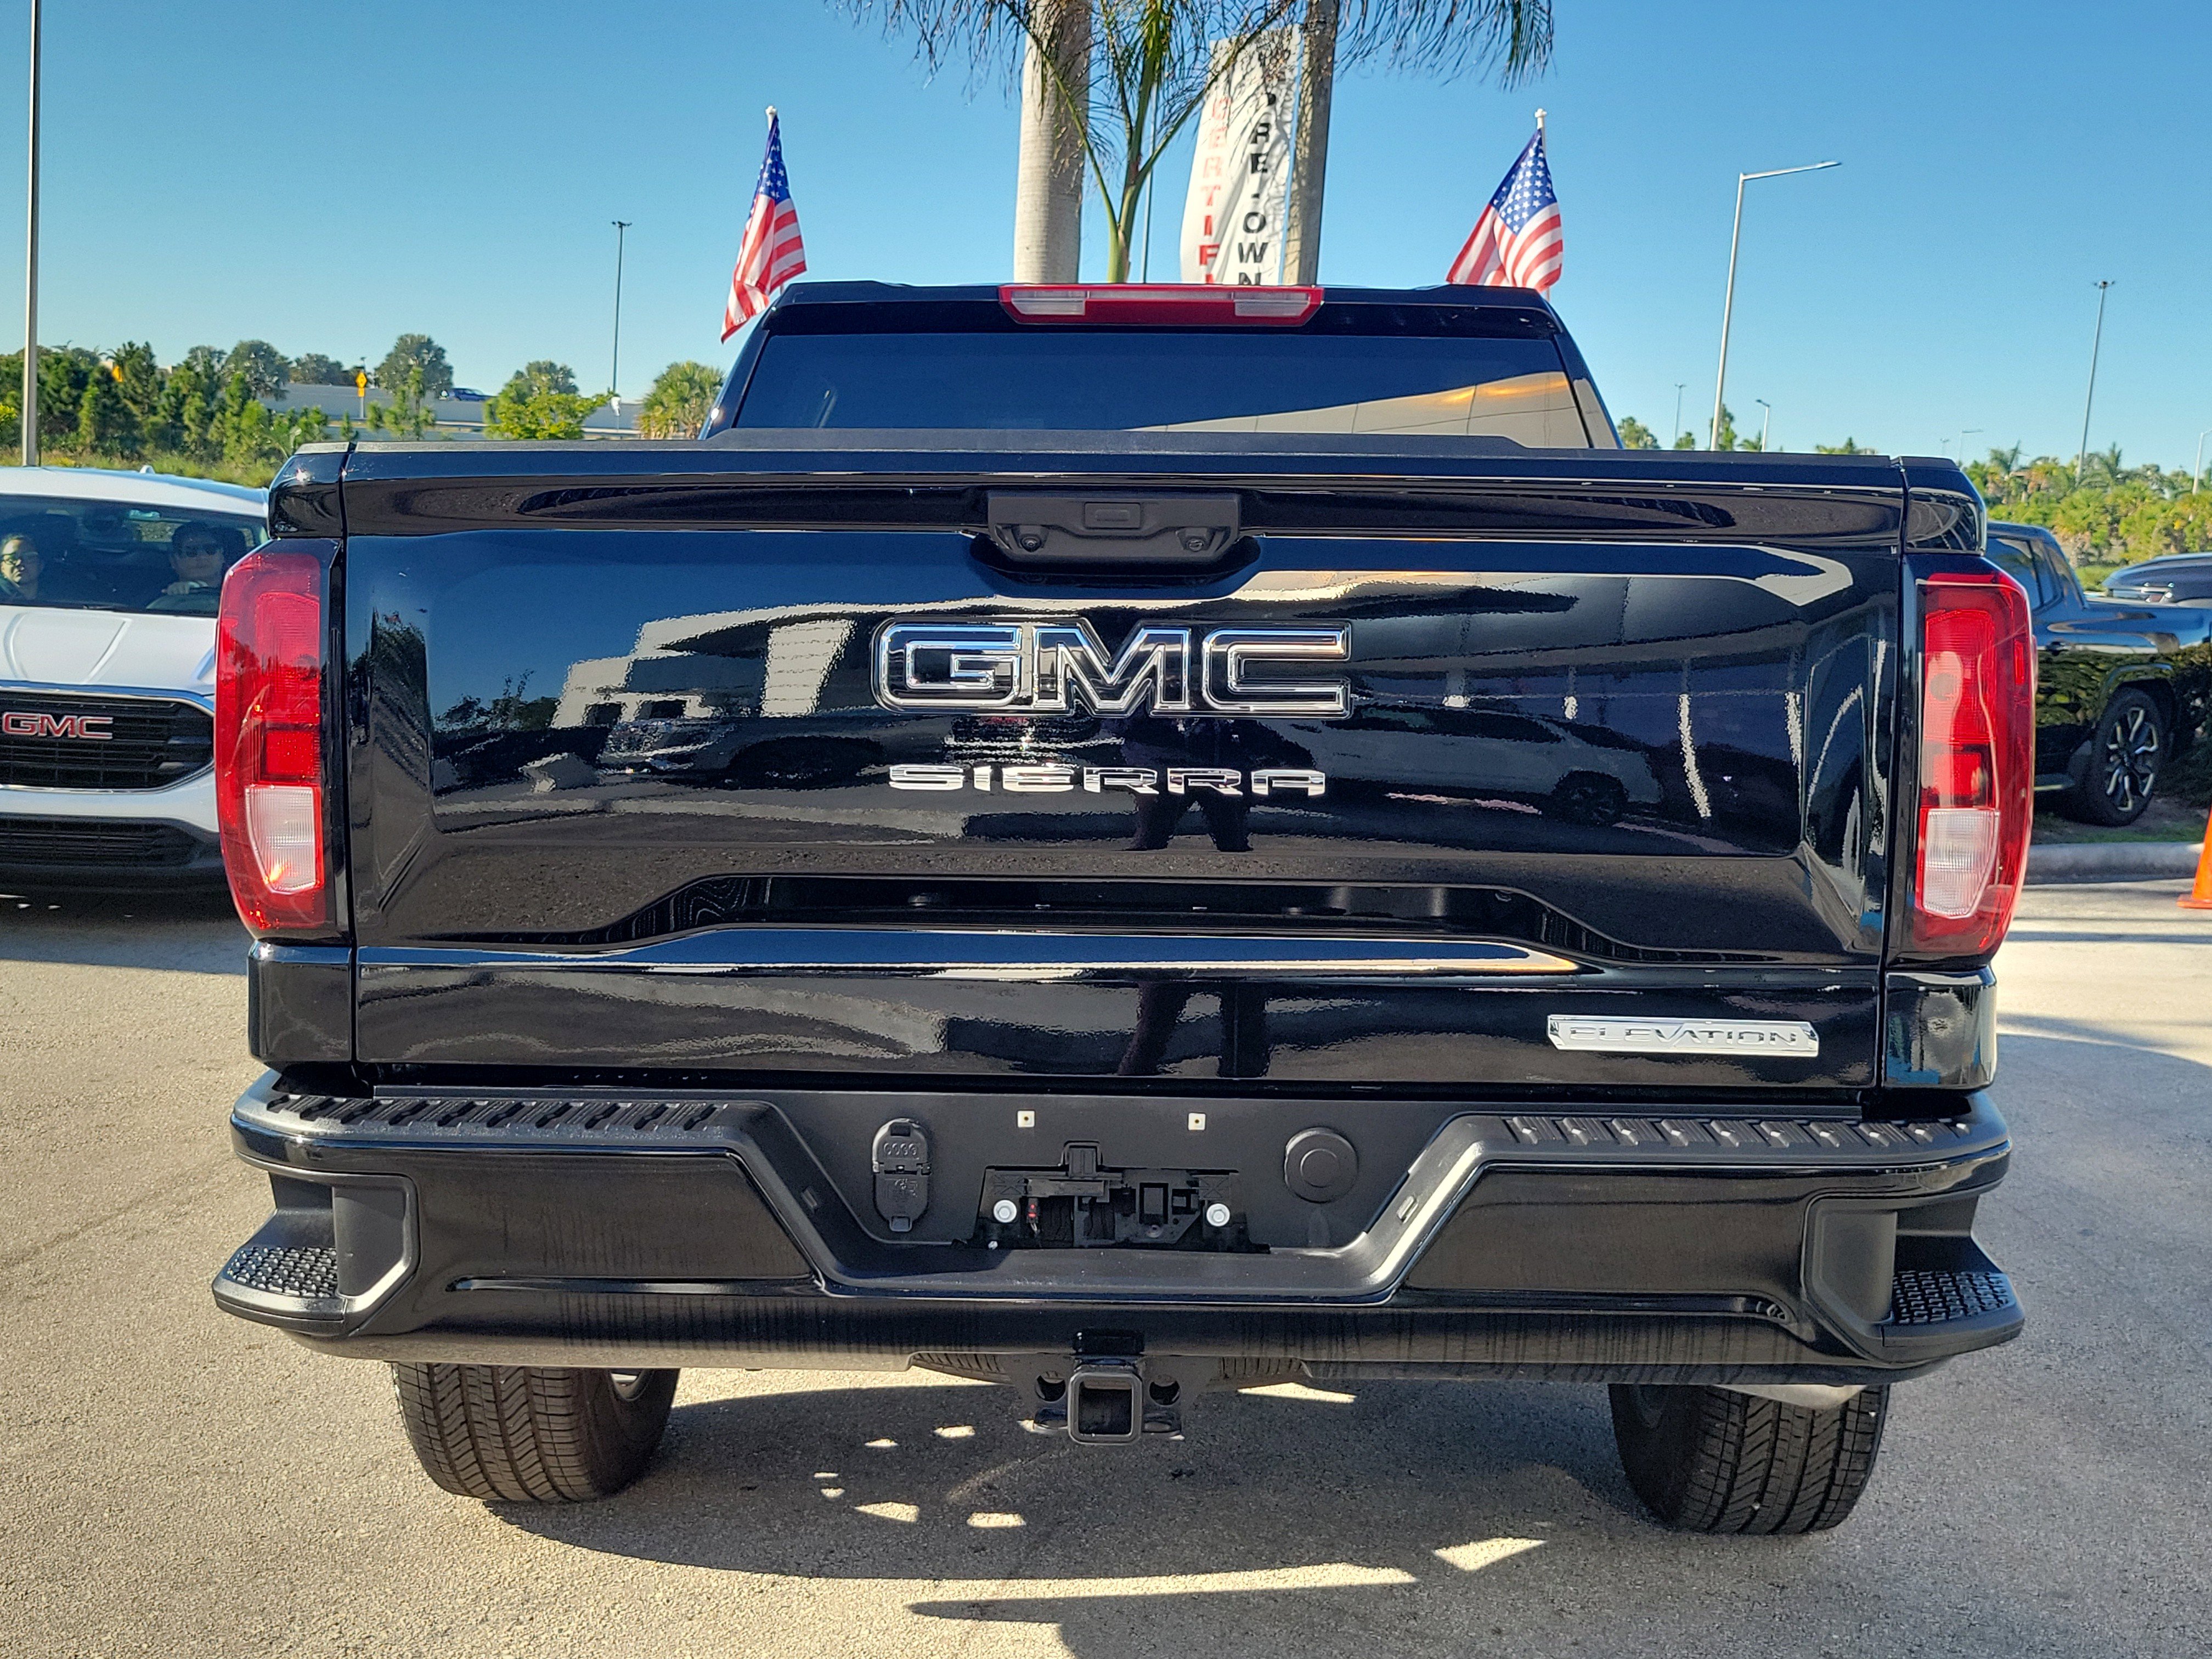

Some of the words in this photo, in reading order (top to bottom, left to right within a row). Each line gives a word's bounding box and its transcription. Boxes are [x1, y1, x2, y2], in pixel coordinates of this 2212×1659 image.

[872, 617, 1352, 719] GMC
[2, 712, 114, 740] GMC
[888, 764, 1327, 797] SIERRA
[1569, 1024, 1797, 1046] ELEVATION
